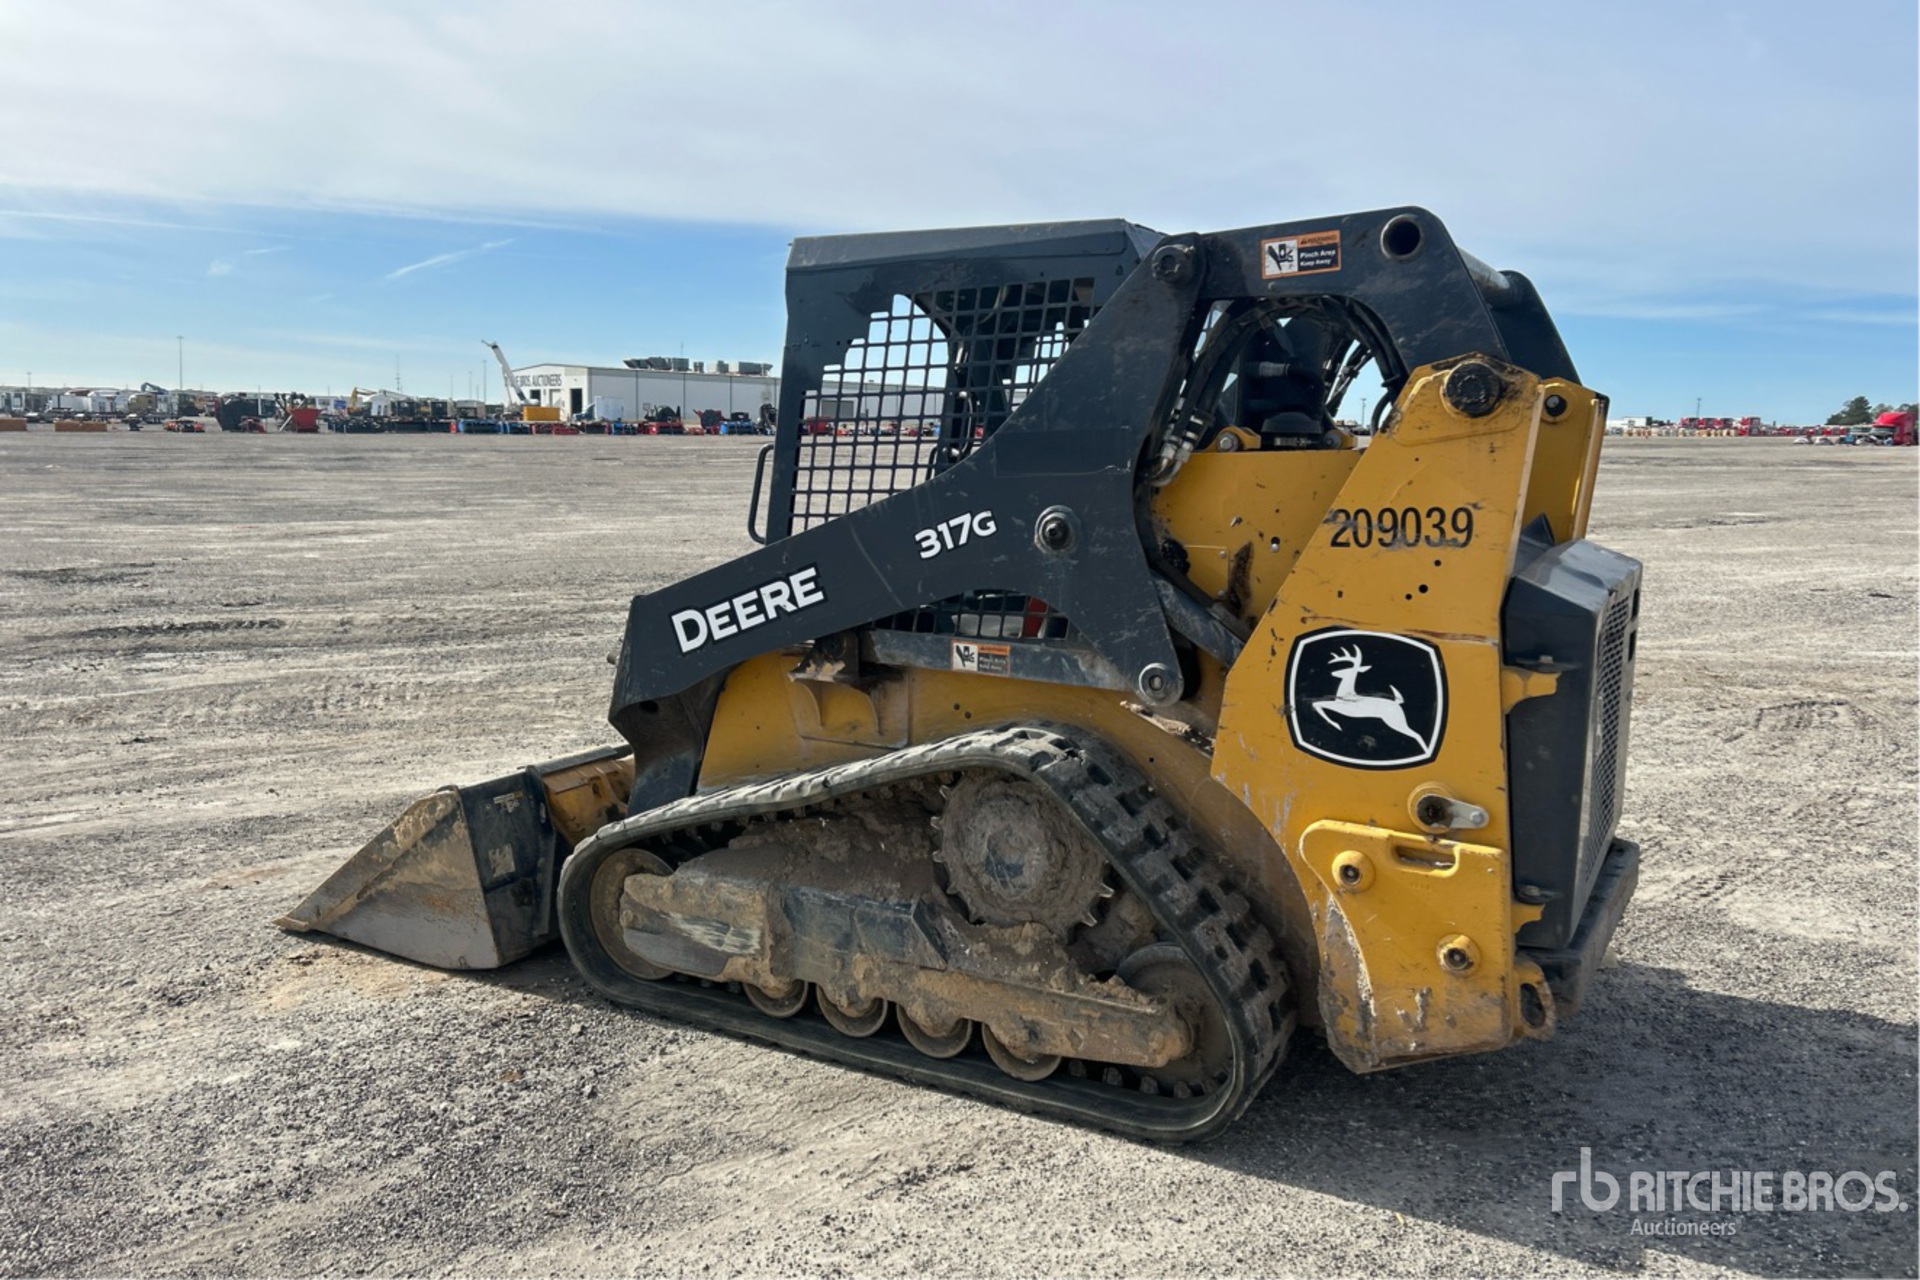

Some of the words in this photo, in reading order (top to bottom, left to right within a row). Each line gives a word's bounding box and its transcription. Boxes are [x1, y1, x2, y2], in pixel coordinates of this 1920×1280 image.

[1300, 251, 1319, 259] Pinch
[915, 510, 997, 559] 317G
[1330, 505, 1474, 548] 209039
[671, 567, 824, 654] DEERE
